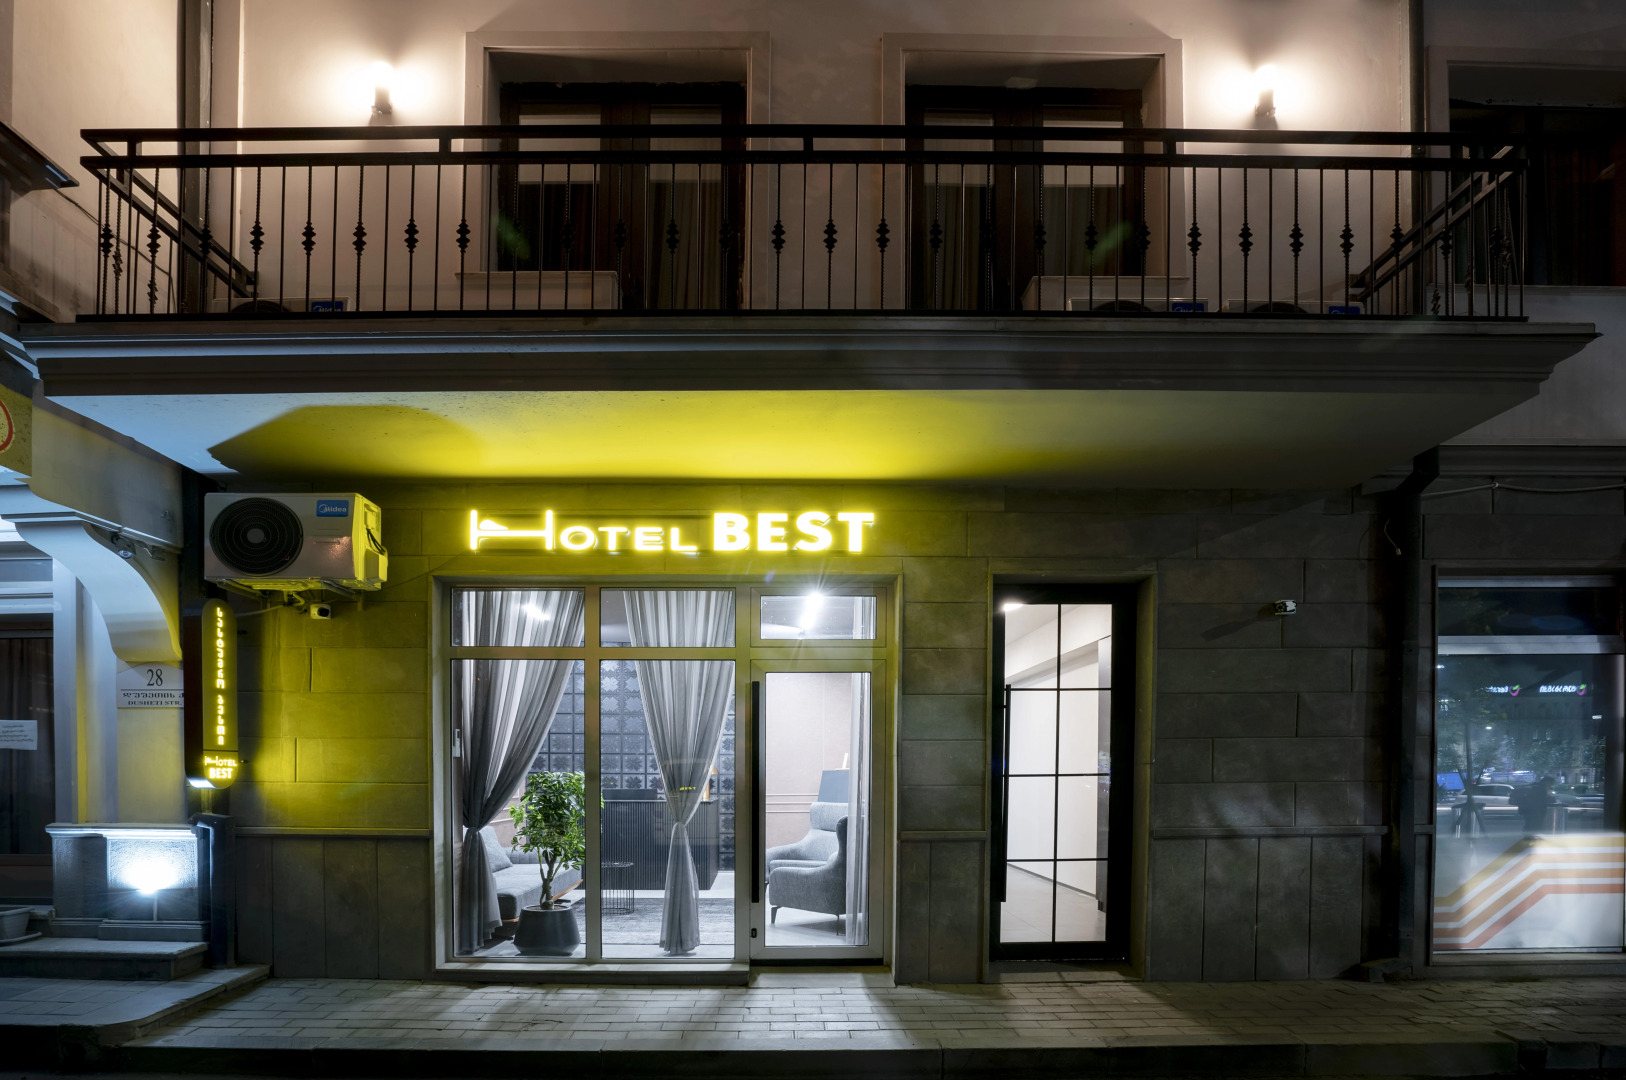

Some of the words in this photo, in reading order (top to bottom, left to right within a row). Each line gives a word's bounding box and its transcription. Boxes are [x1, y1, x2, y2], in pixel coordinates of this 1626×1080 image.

[321, 505, 347, 514] Midea
[469, 509, 699, 552] HOTEL
[712, 511, 876, 553] BEST
[216, 606, 226, 689] სასტუმრო
[146, 668, 164, 687] 28
[216, 694, 226, 746] ბესთი
[204, 755, 238, 767] HOTEL
[209, 767, 233, 779] BEST
